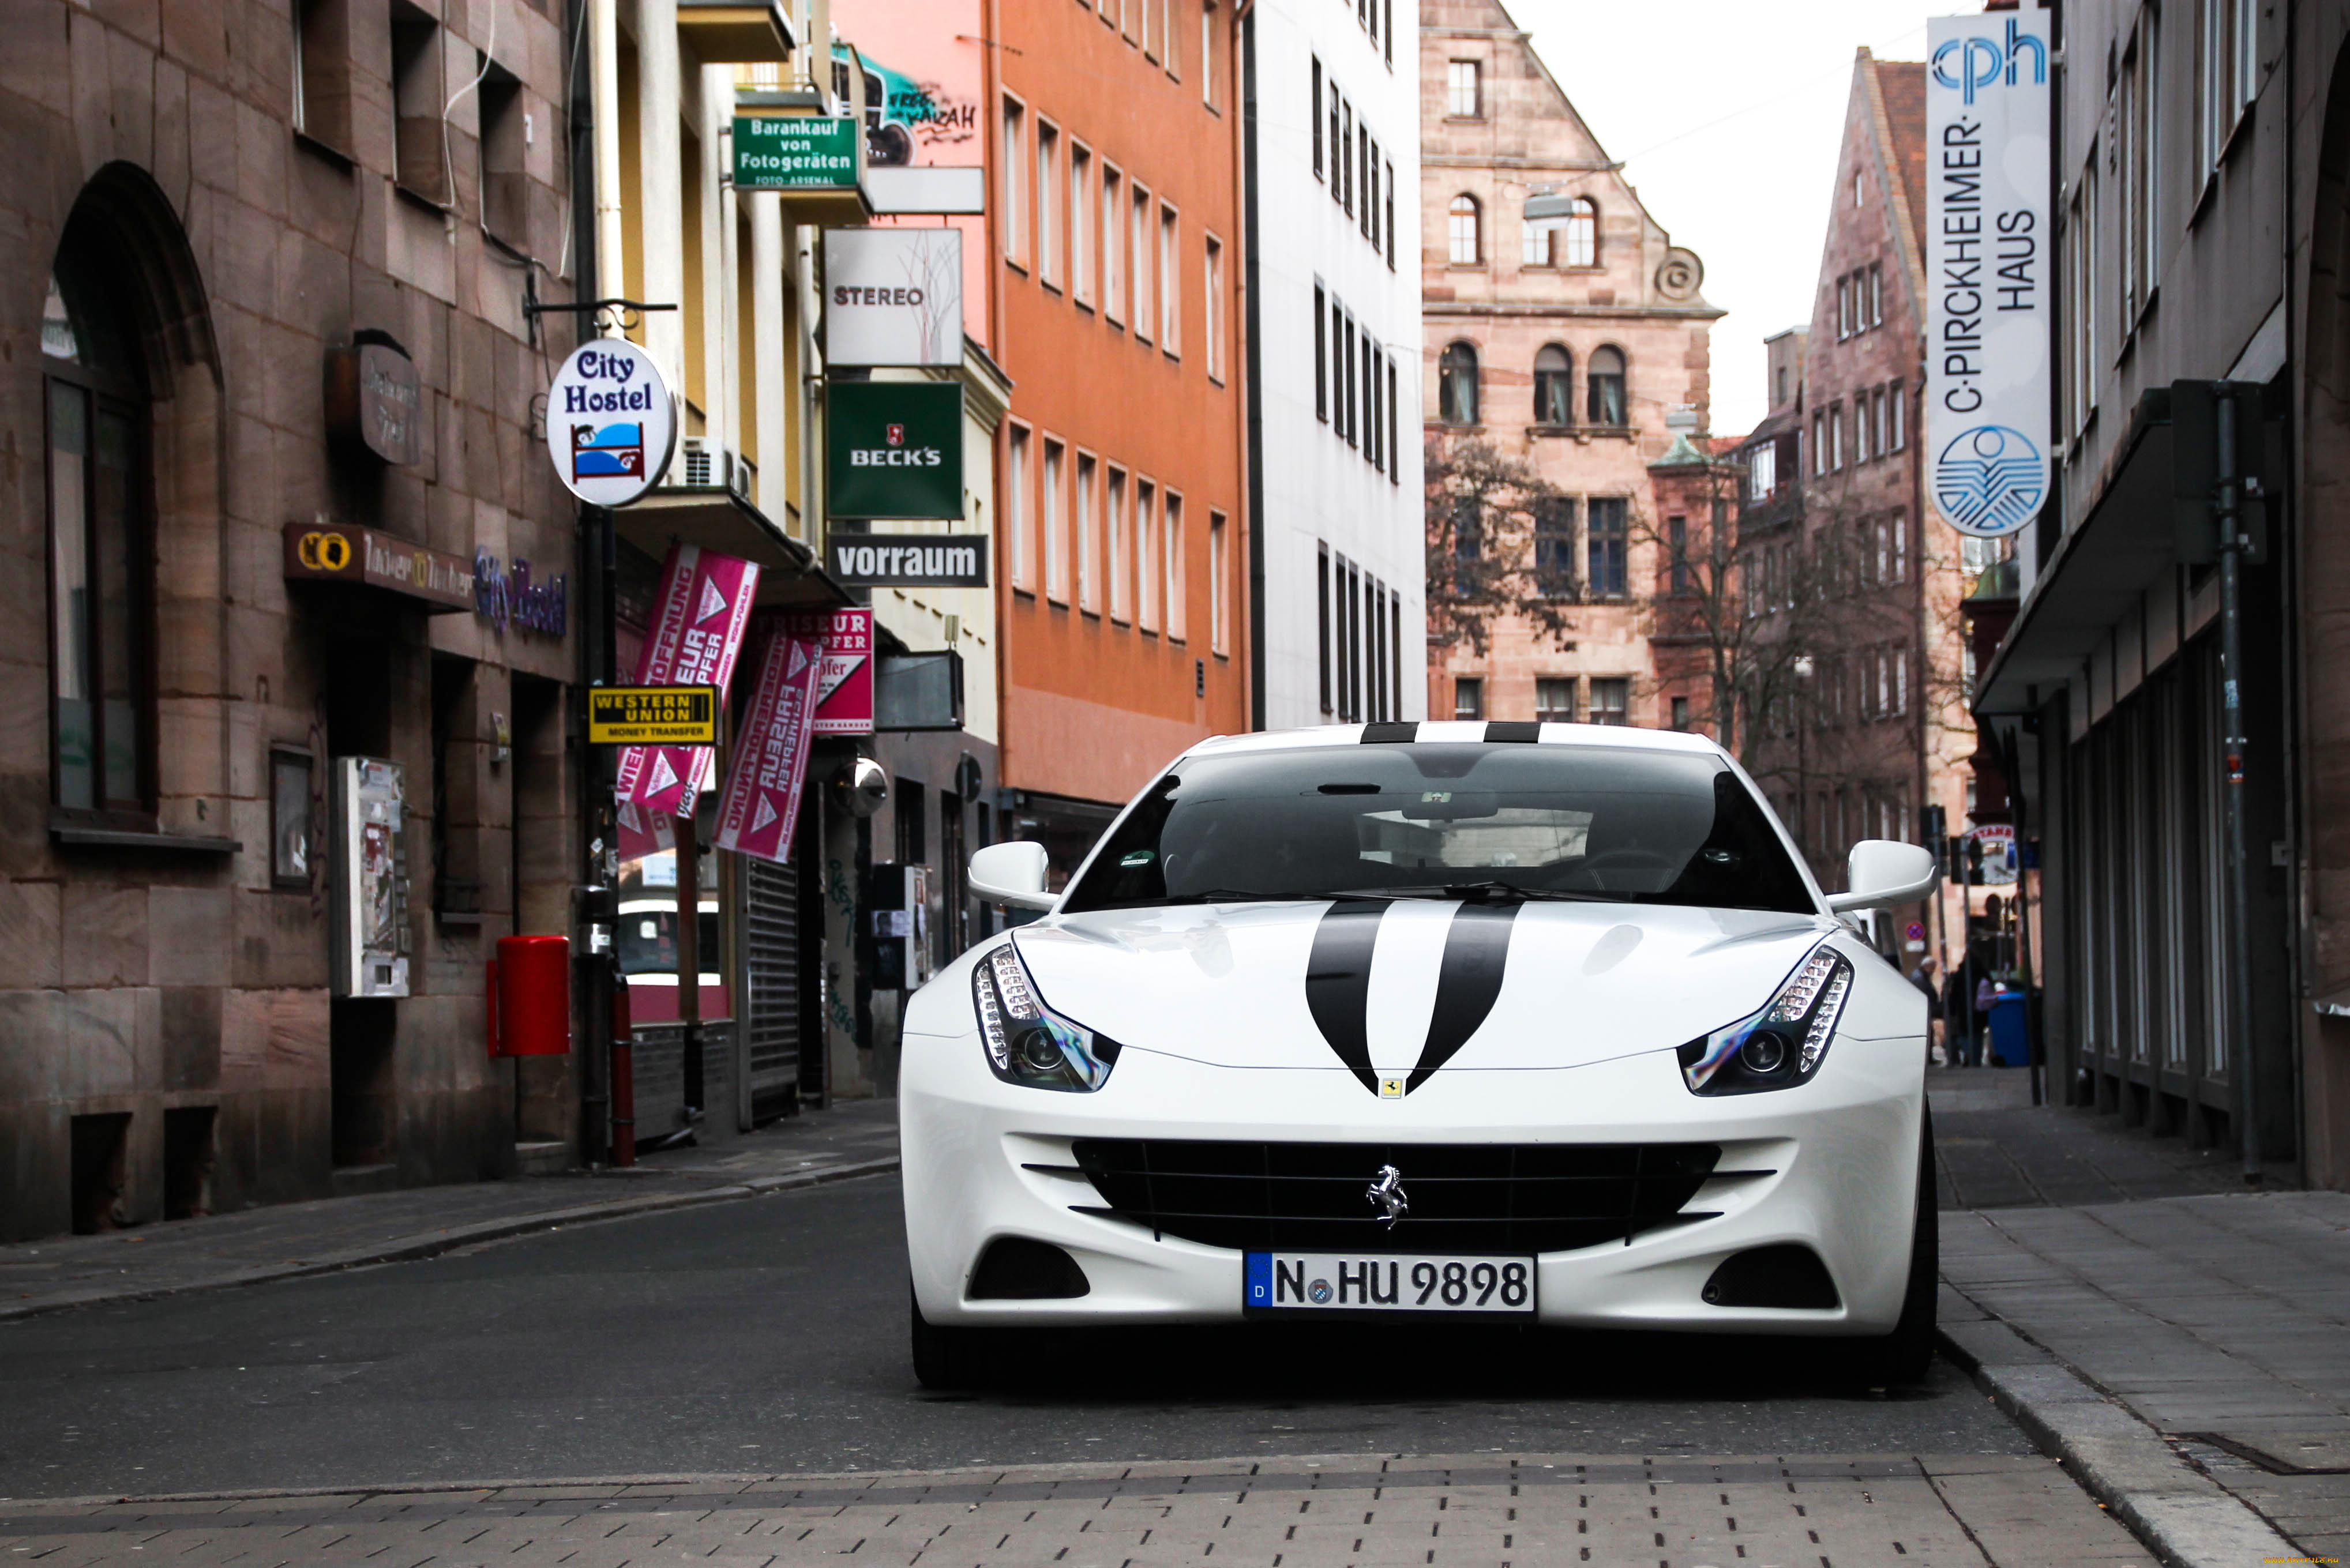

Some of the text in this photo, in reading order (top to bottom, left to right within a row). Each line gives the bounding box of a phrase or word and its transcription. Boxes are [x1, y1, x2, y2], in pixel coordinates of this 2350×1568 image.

[751, 119, 839, 136] Barankauf
[780, 140, 811, 152] von
[741, 151, 851, 172] Fotogeräten
[1997, 209, 2035, 311] HAUS
[834, 287, 924, 306] STEREO
[577, 350, 635, 383] City
[564, 383, 652, 413] Hostel
[838, 546, 976, 577] vorraum
[596, 695, 690, 709] WESTERN
[625, 709, 690, 721] UNION
[608, 727, 704, 736] MONEY TRANSFER
[1255, 1259, 1529, 1307] D N HU 9898
